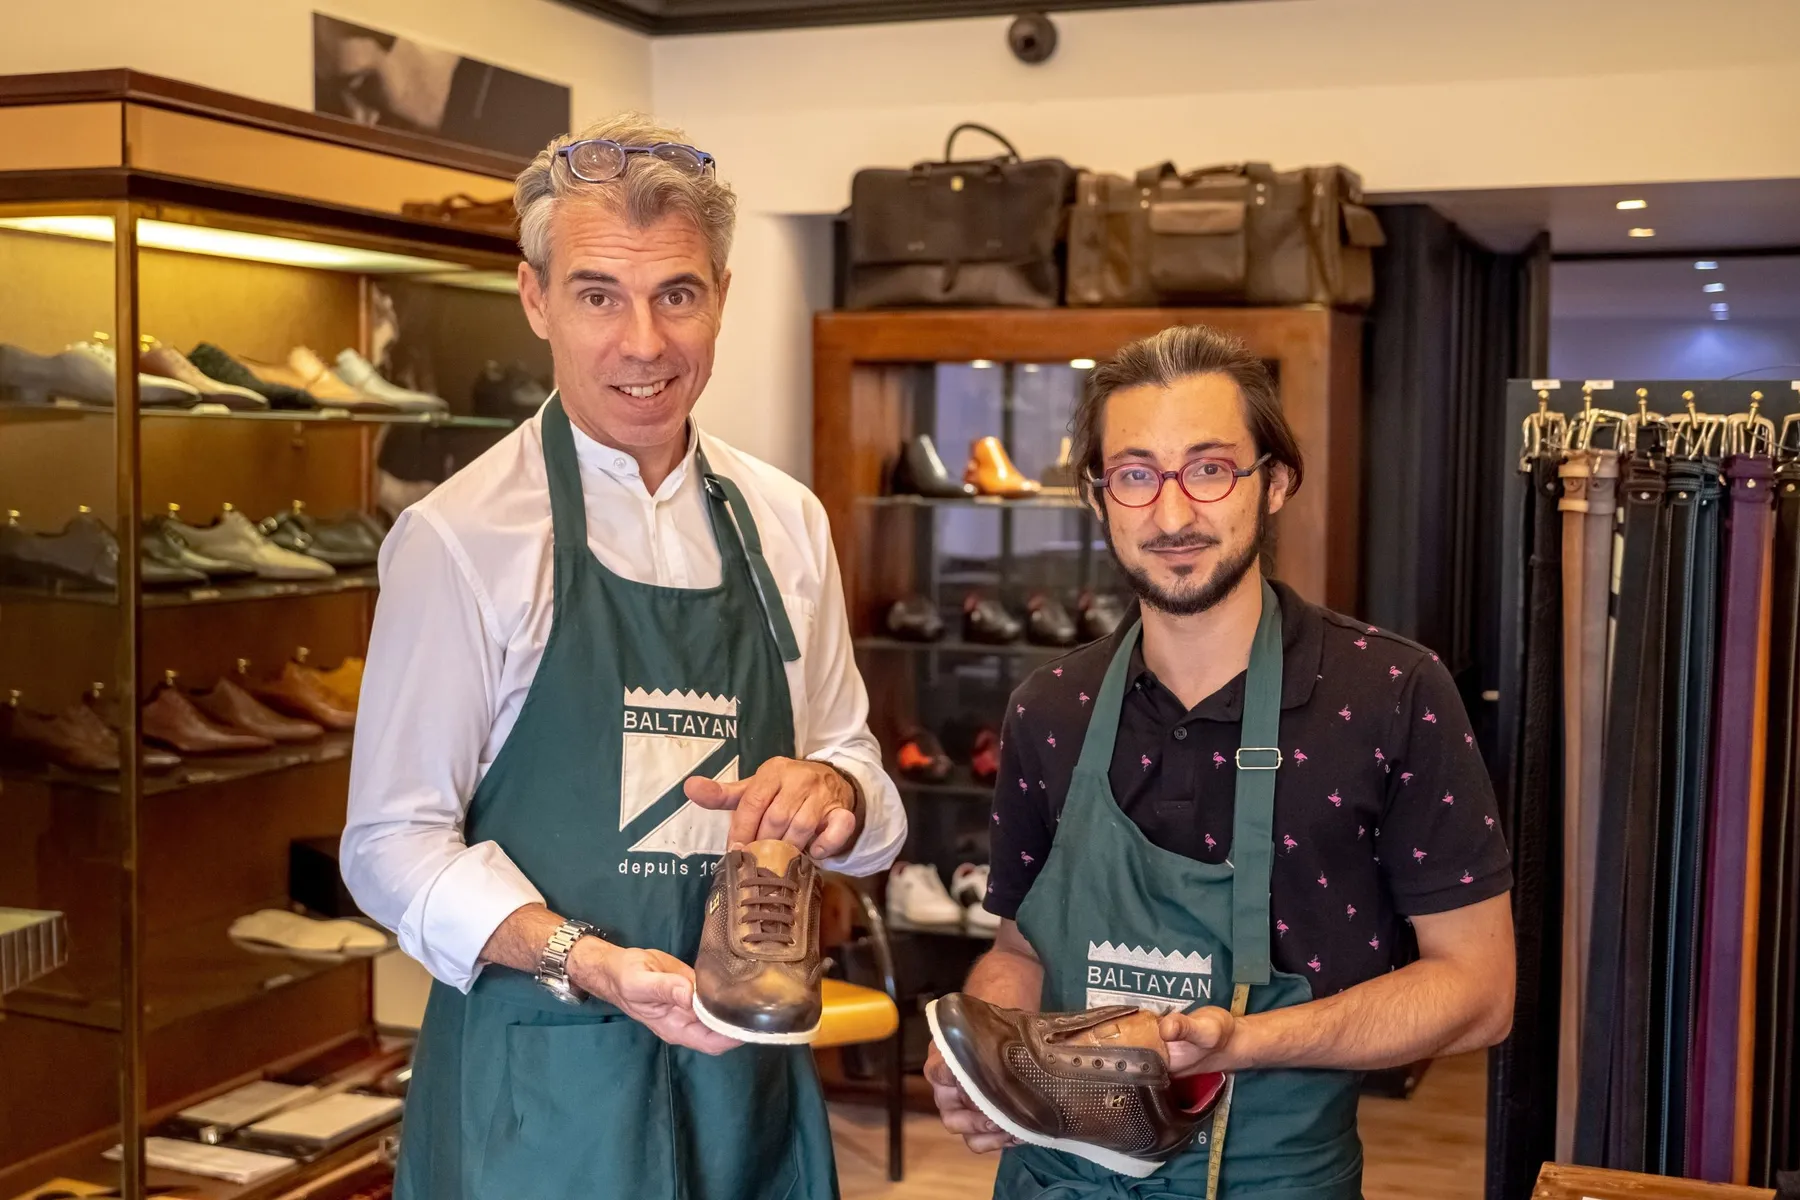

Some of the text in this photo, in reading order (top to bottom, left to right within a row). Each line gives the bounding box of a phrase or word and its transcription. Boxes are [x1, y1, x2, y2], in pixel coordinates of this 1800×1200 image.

[623, 710, 738, 739] BALTAYAN
[618, 858, 689, 877] depuis
[1087, 965, 1212, 999] BALTAYAN
